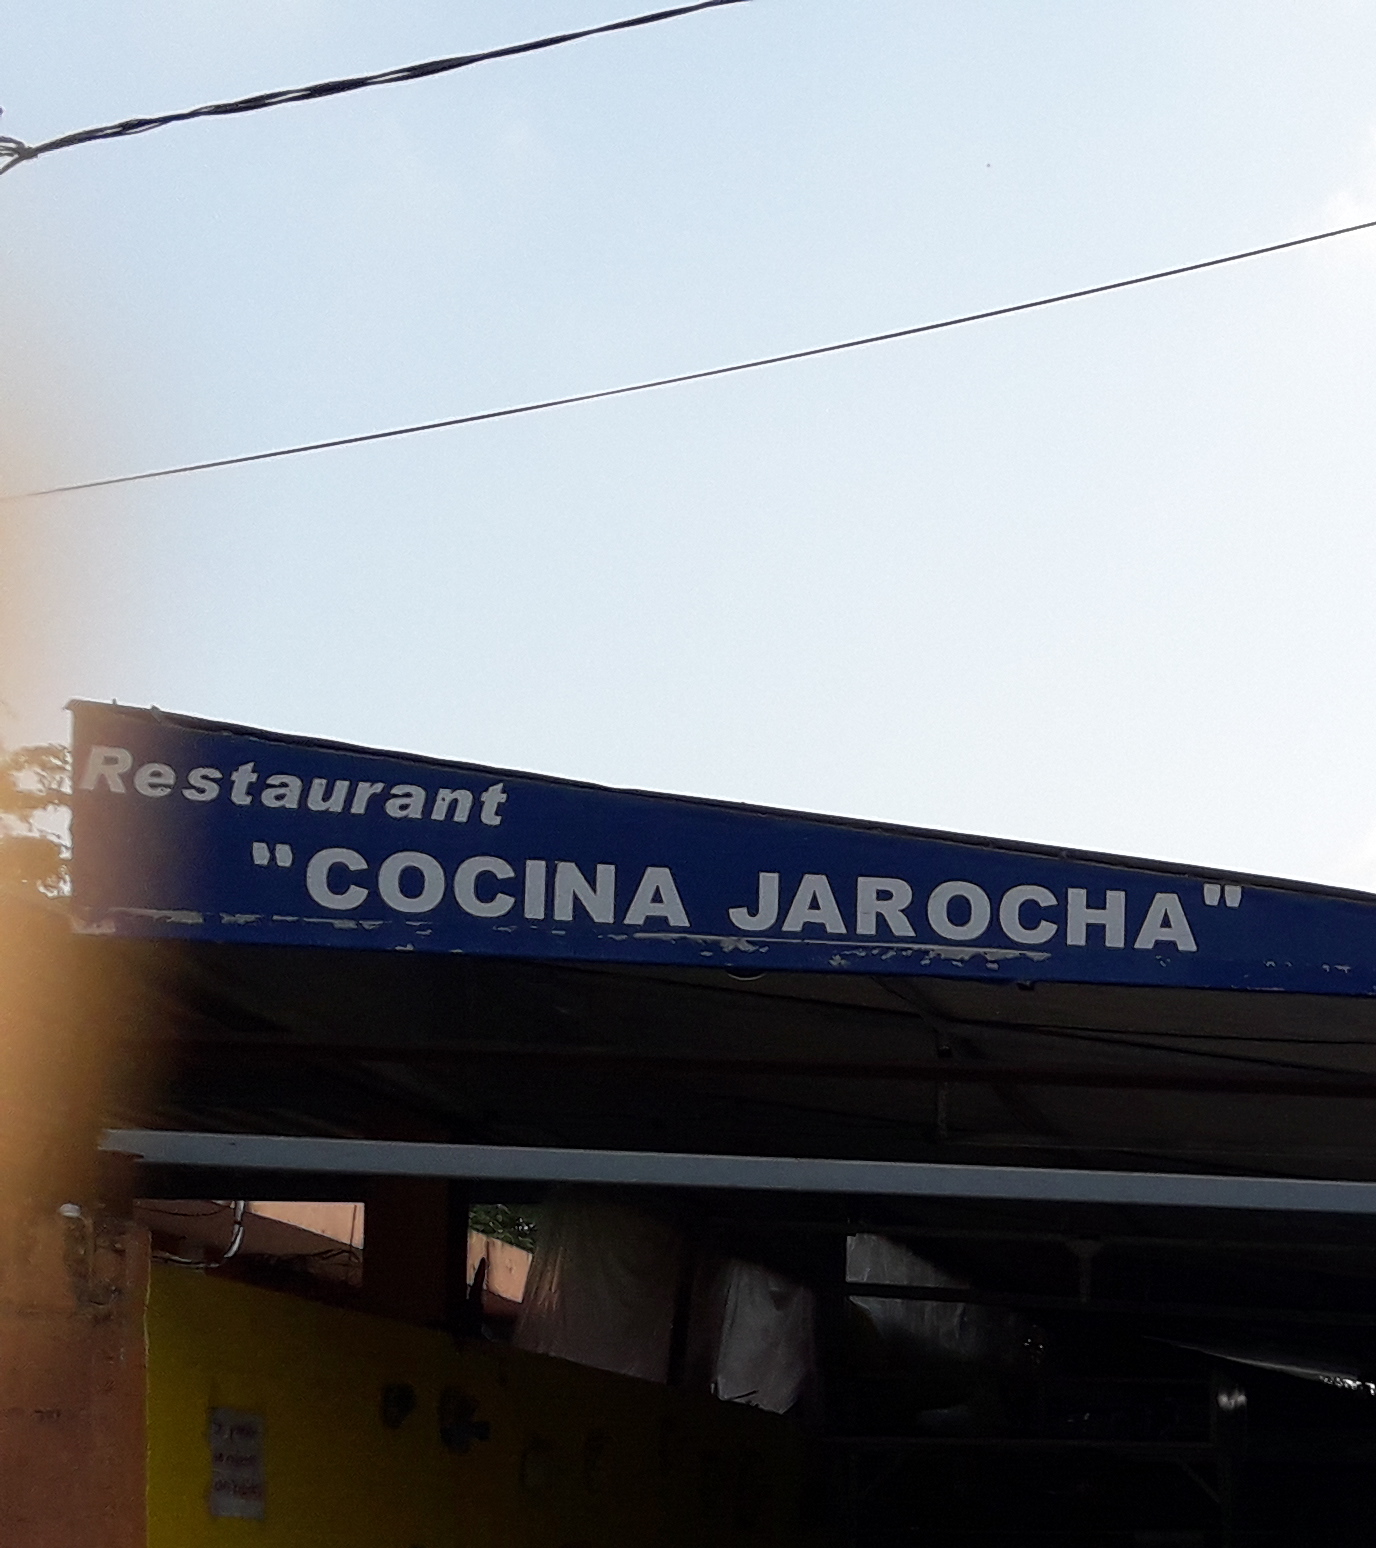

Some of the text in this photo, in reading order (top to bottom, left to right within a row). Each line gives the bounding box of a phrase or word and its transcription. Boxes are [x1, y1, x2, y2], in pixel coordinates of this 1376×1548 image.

[79, 746, 508, 826] Restaurant
[252, 841, 1242, 951] "COCINA JAROCHA"
